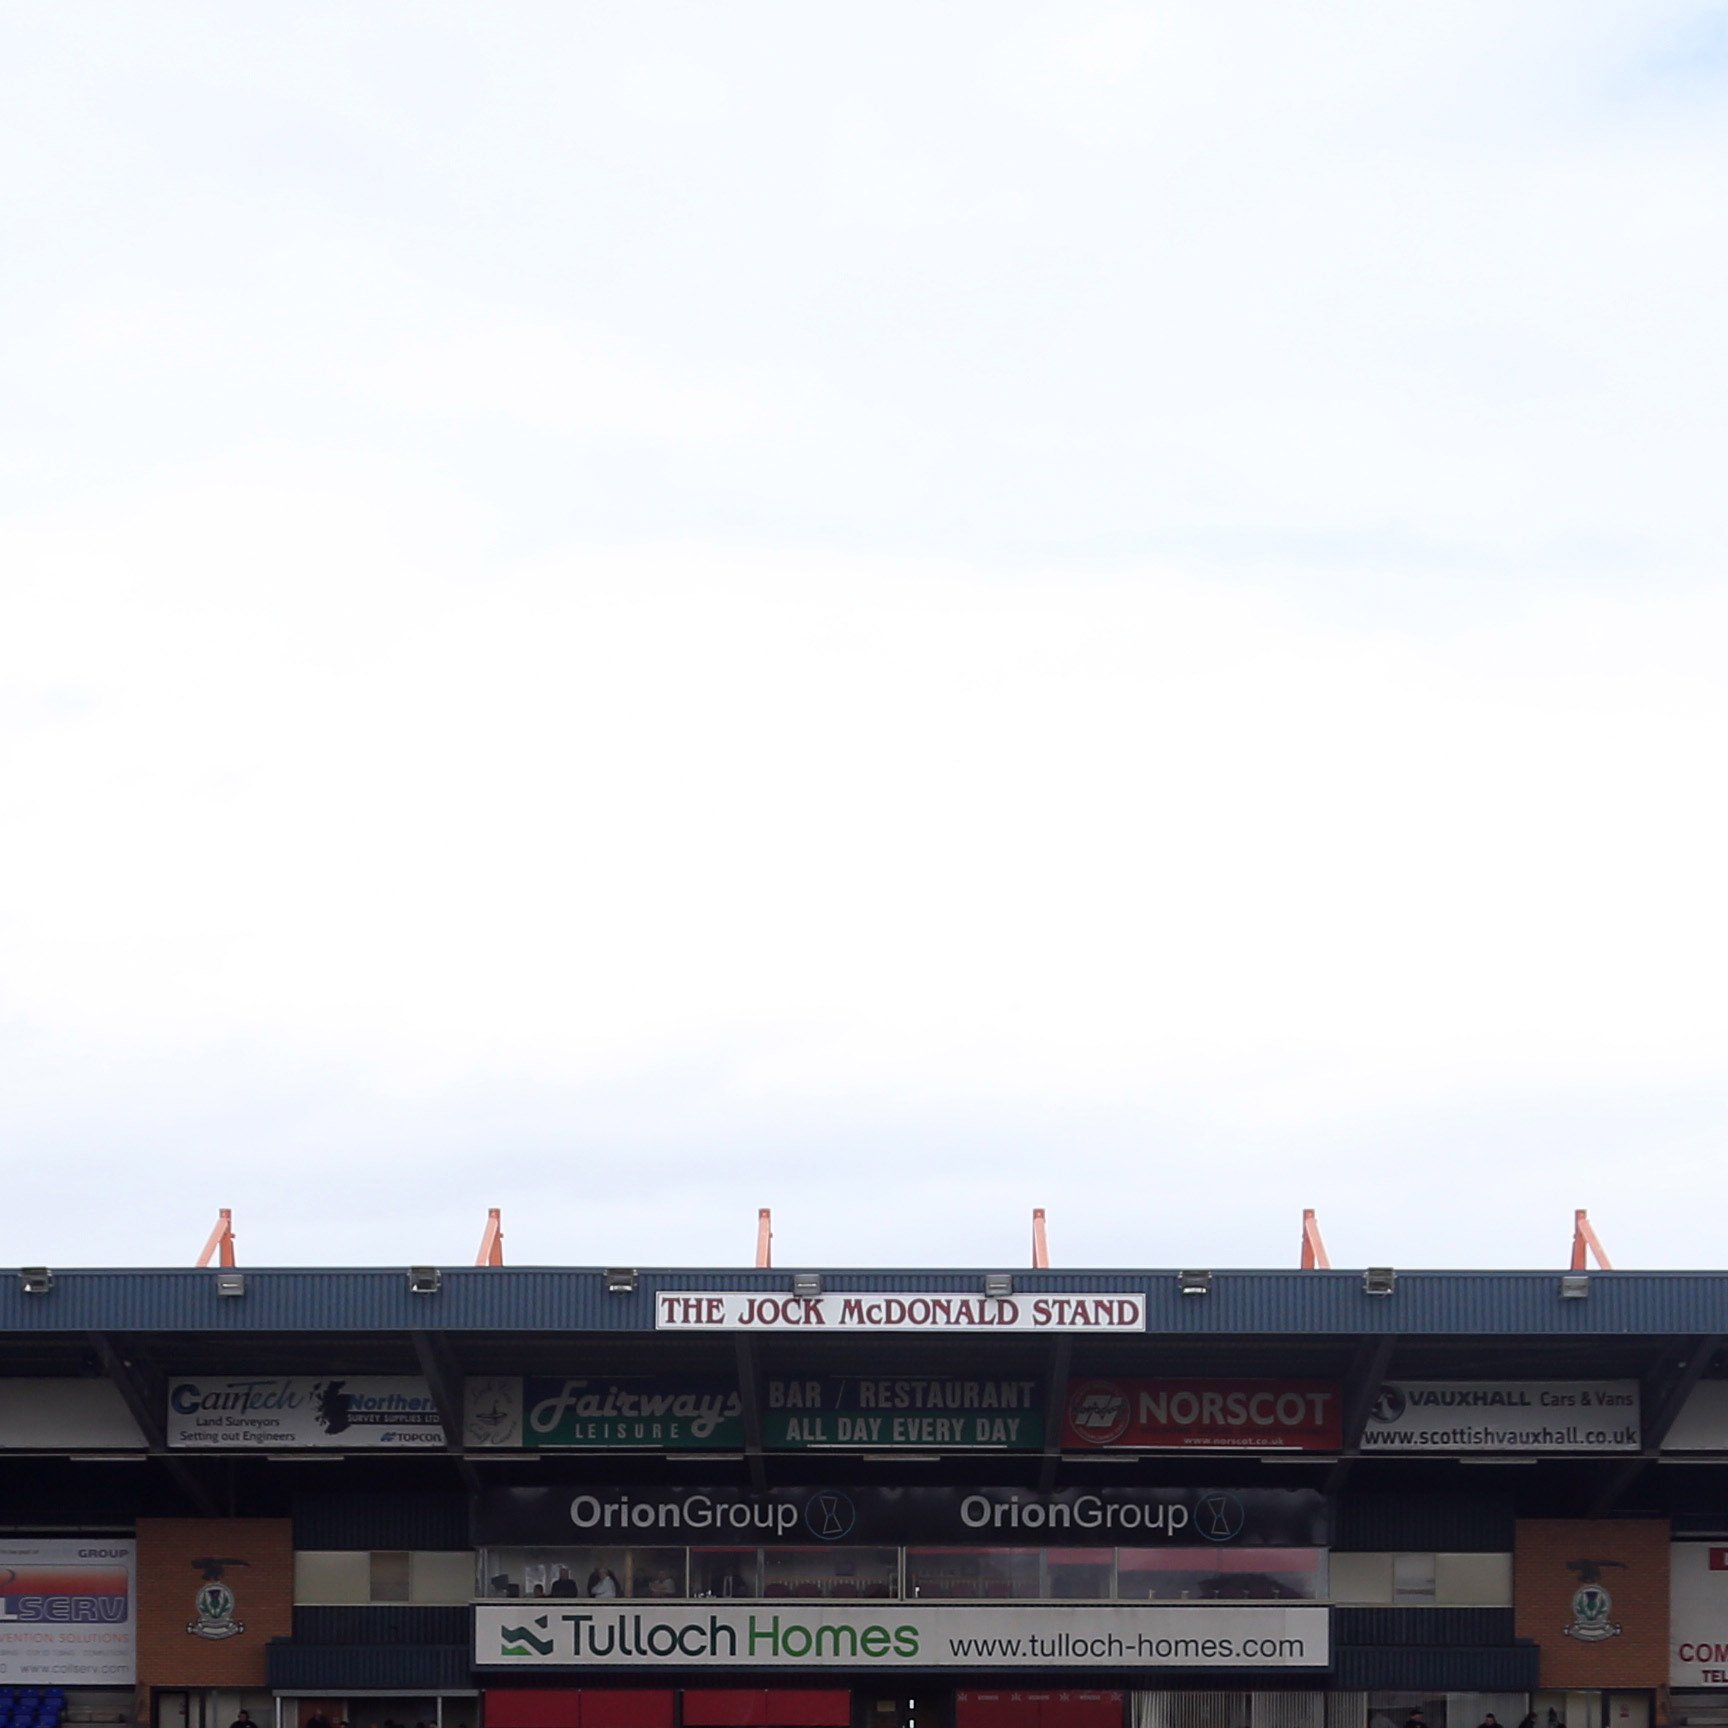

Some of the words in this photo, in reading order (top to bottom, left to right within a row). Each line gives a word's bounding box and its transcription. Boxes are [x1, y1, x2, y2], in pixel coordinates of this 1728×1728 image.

[661, 1298, 725, 1326] THE
[738, 1298, 826, 1326] JOCK
[838, 1298, 1020, 1326] McDONALD
[1033, 1298, 1140, 1326] STAND
[769, 1381, 822, 1408] BAR
[859, 1381, 1035, 1408] RESTAURANT
[1409, 1391, 1531, 1406] VAUXHALL
[1540, 1391, 1575, 1406] Cars
[1596, 1391, 1633, 1406] Vans
[530, 1381, 742, 1439] Fairways
[1138, 1392, 1332, 1426] NORSCOT
[196, 1417, 222, 1428] Land
[226, 1417, 280, 1428] Surveyors
[575, 1423, 679, 1439] LEISURE
[786, 1417, 827, 1441] ALL
[837, 1417, 882, 1441] DAY
[893, 1417, 966, 1441] EVERY
[976, 1417, 1021, 1441] DAY
[180, 1431, 219, 1443] Setting
[243, 1431, 295, 1443] Engineers
[1365, 1427, 1637, 1445] www.scottishvauxhall.co.uk
[570, 1495, 799, 1536] OrionGroup
[960, 1496, 1189, 1537] OrionGroup
[78, 1550, 129, 1559] GROUP
[59, 1634, 129, 1643] SOLUTIONS
[562, 1615, 736, 1657] Tulloch
[748, 1615, 920, 1657] Homes
[949, 1633, 1305, 1659] www.tulloch-homes.com
